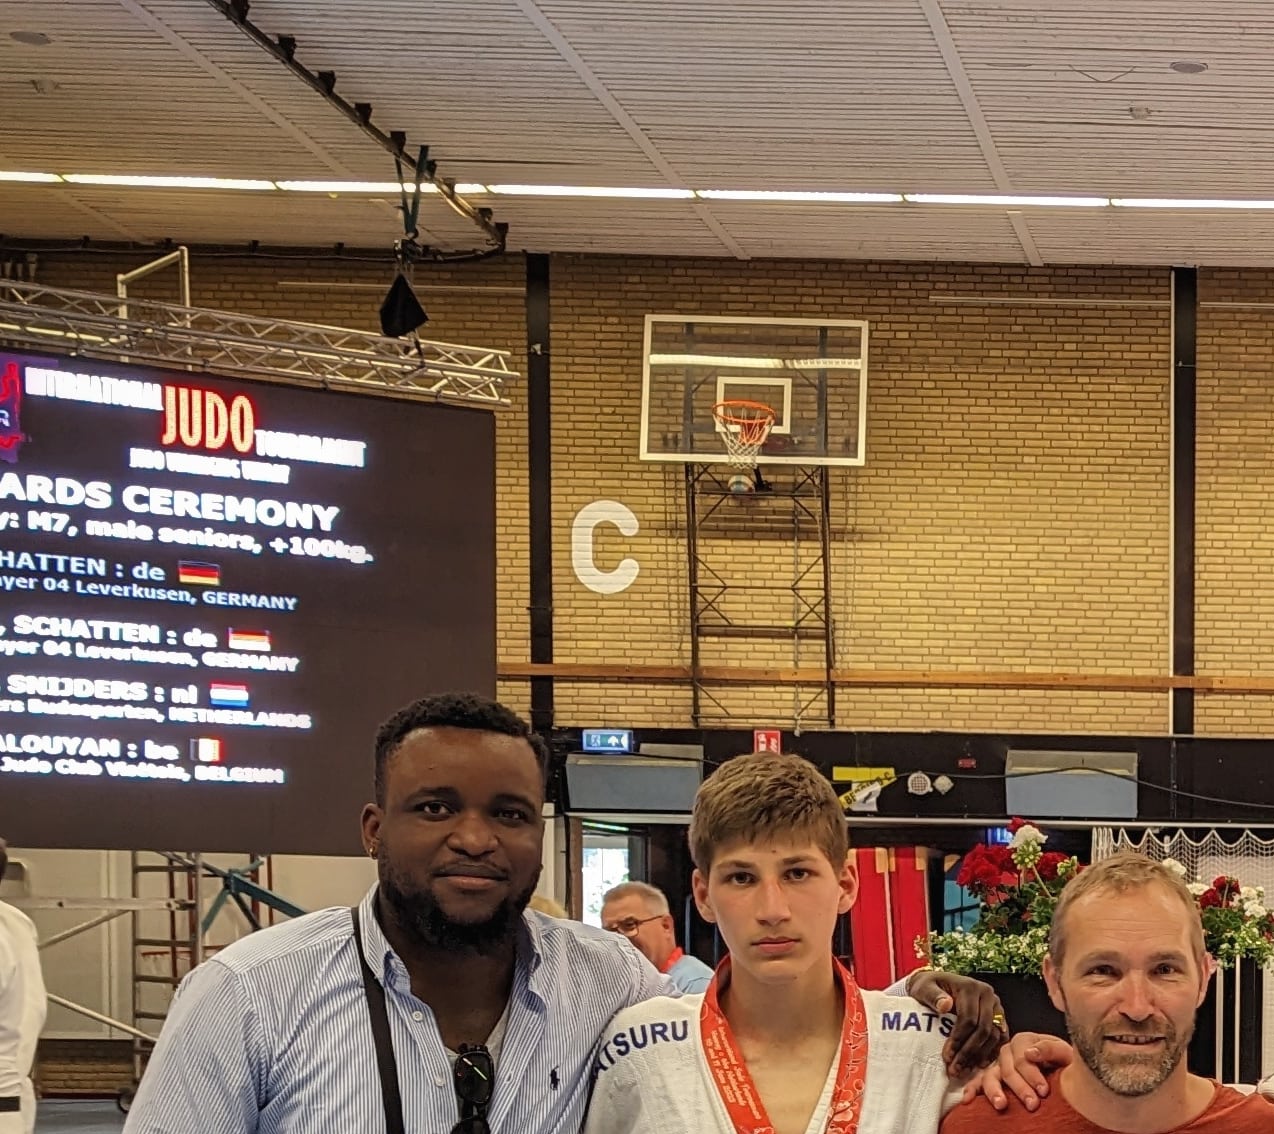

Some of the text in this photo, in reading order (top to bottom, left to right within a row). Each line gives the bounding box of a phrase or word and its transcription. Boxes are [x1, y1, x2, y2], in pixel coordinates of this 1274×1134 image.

[161, 386, 256, 453] JUDO
[122, 485, 340, 531] CEREMONY
[27, 511, 78, 537] M7,
[86, 520, 153, 540] male
[158, 527, 262, 554] seniors,
[571, 500, 640, 595] C
[132, 561, 165, 581] de
[43, 577, 70, 592] 04
[76, 579, 197, 605] Leverkusen,
[202, 591, 297, 610] GERMANY
[13, 615, 160, 644] SCHATTEN
[183, 628, 218, 648] de
[202, 651, 300, 672] GERMANY
[7, 674, 148, 702] SNIJDERS
[171, 685, 198, 705] nl
[169, 707, 312, 729] NETHERLANDS
[145, 739, 179, 760] be
[54, 758, 103, 776] Club
[194, 765, 285, 783] BELGIUM
